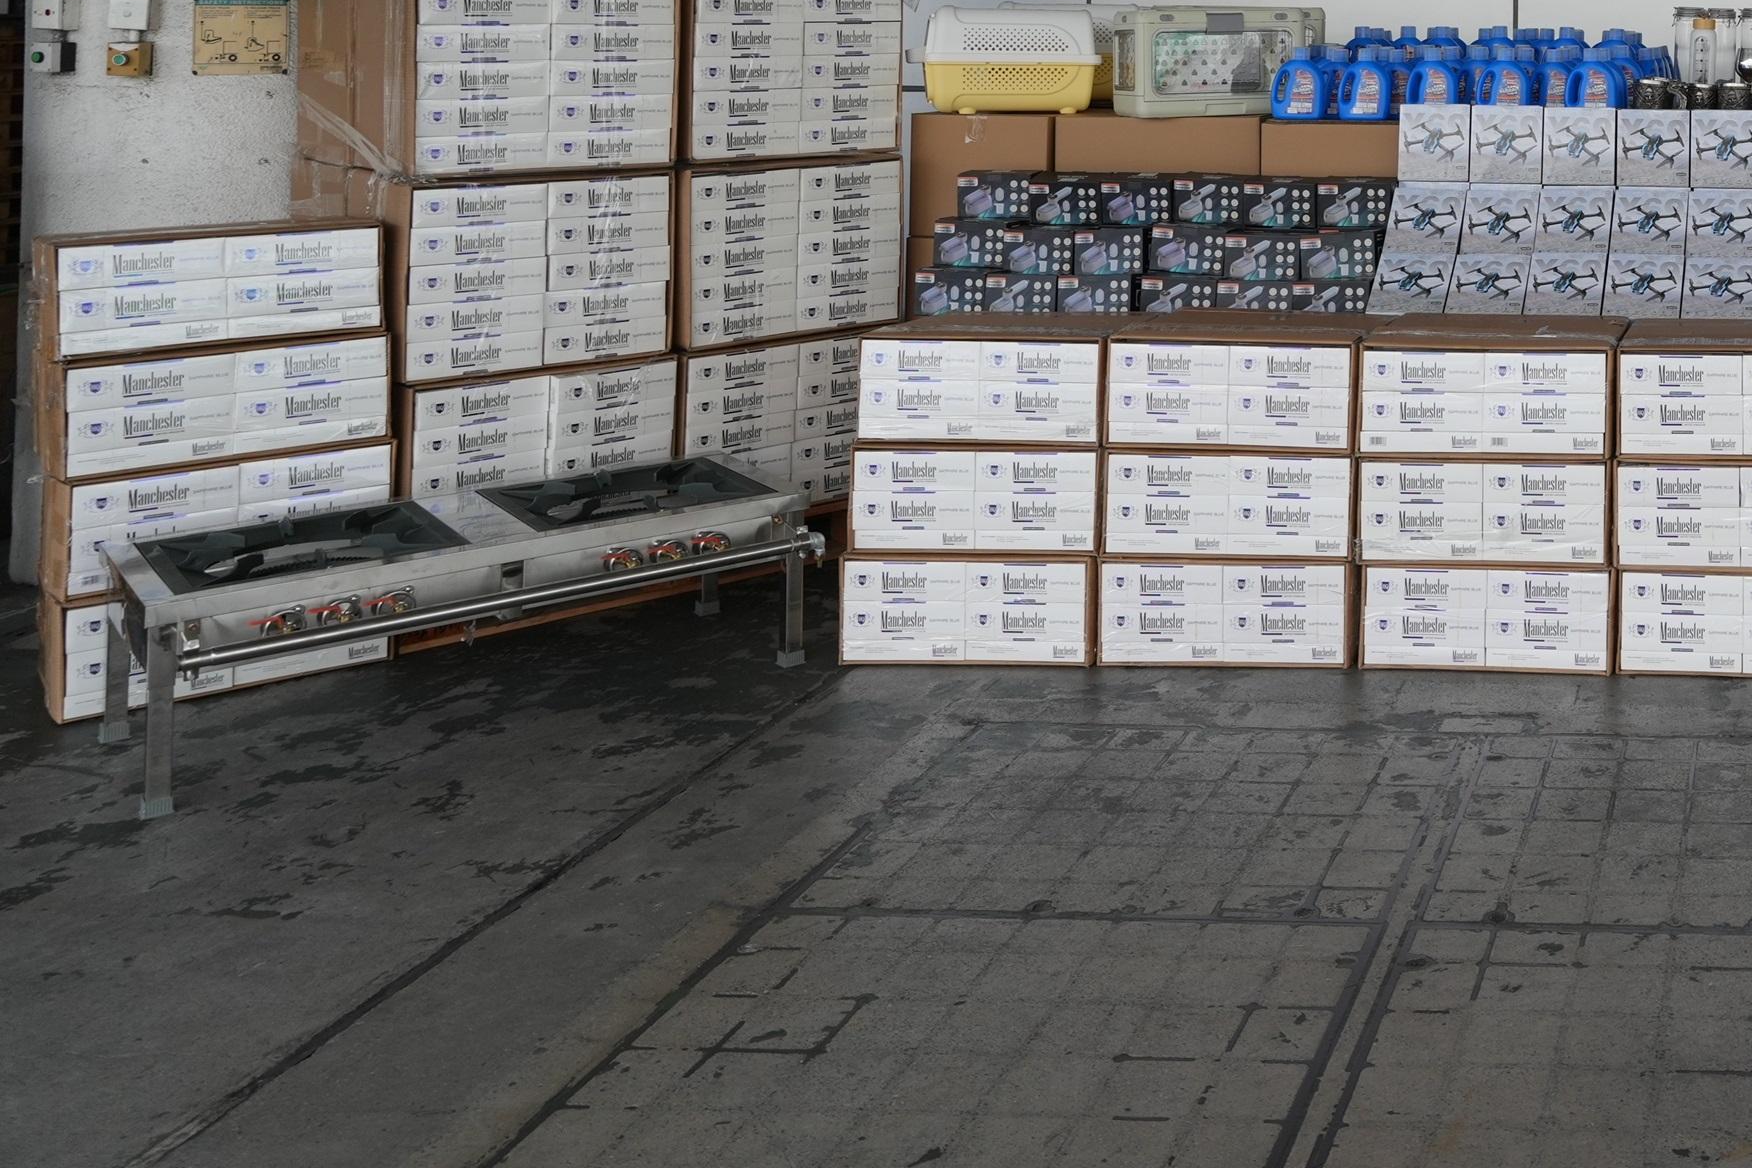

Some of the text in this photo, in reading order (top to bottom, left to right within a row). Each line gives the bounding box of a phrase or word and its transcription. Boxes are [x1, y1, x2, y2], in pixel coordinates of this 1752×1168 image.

[725, 177, 767, 197] Manchester
[724, 211, 766, 231] Manchester
[832, 233, 871, 252] Manchester
[113, 246, 175, 274] Manchester
[1148, 353, 1191, 371] Manchester
[1267, 356, 1312, 373] Manchester
[123, 365, 185, 393] Manchester
[1659, 365, 1704, 382] Manchester
[284, 387, 343, 415] Manchester
[461, 390, 510, 412] Manchester
[892, 461, 937, 478] Manchester
[1013, 462, 1058, 479] Manchester
[128, 479, 190, 507] Manchester
[1657, 477, 1702, 494] Manchester
[1521, 513, 1566, 530] Manchester
[882, 572, 927, 589] Manchester
[1261, 575, 1306, 592] Manchester
[1661, 584, 1706, 601] Manchester
[1140, 612, 1185, 629] Manchester
